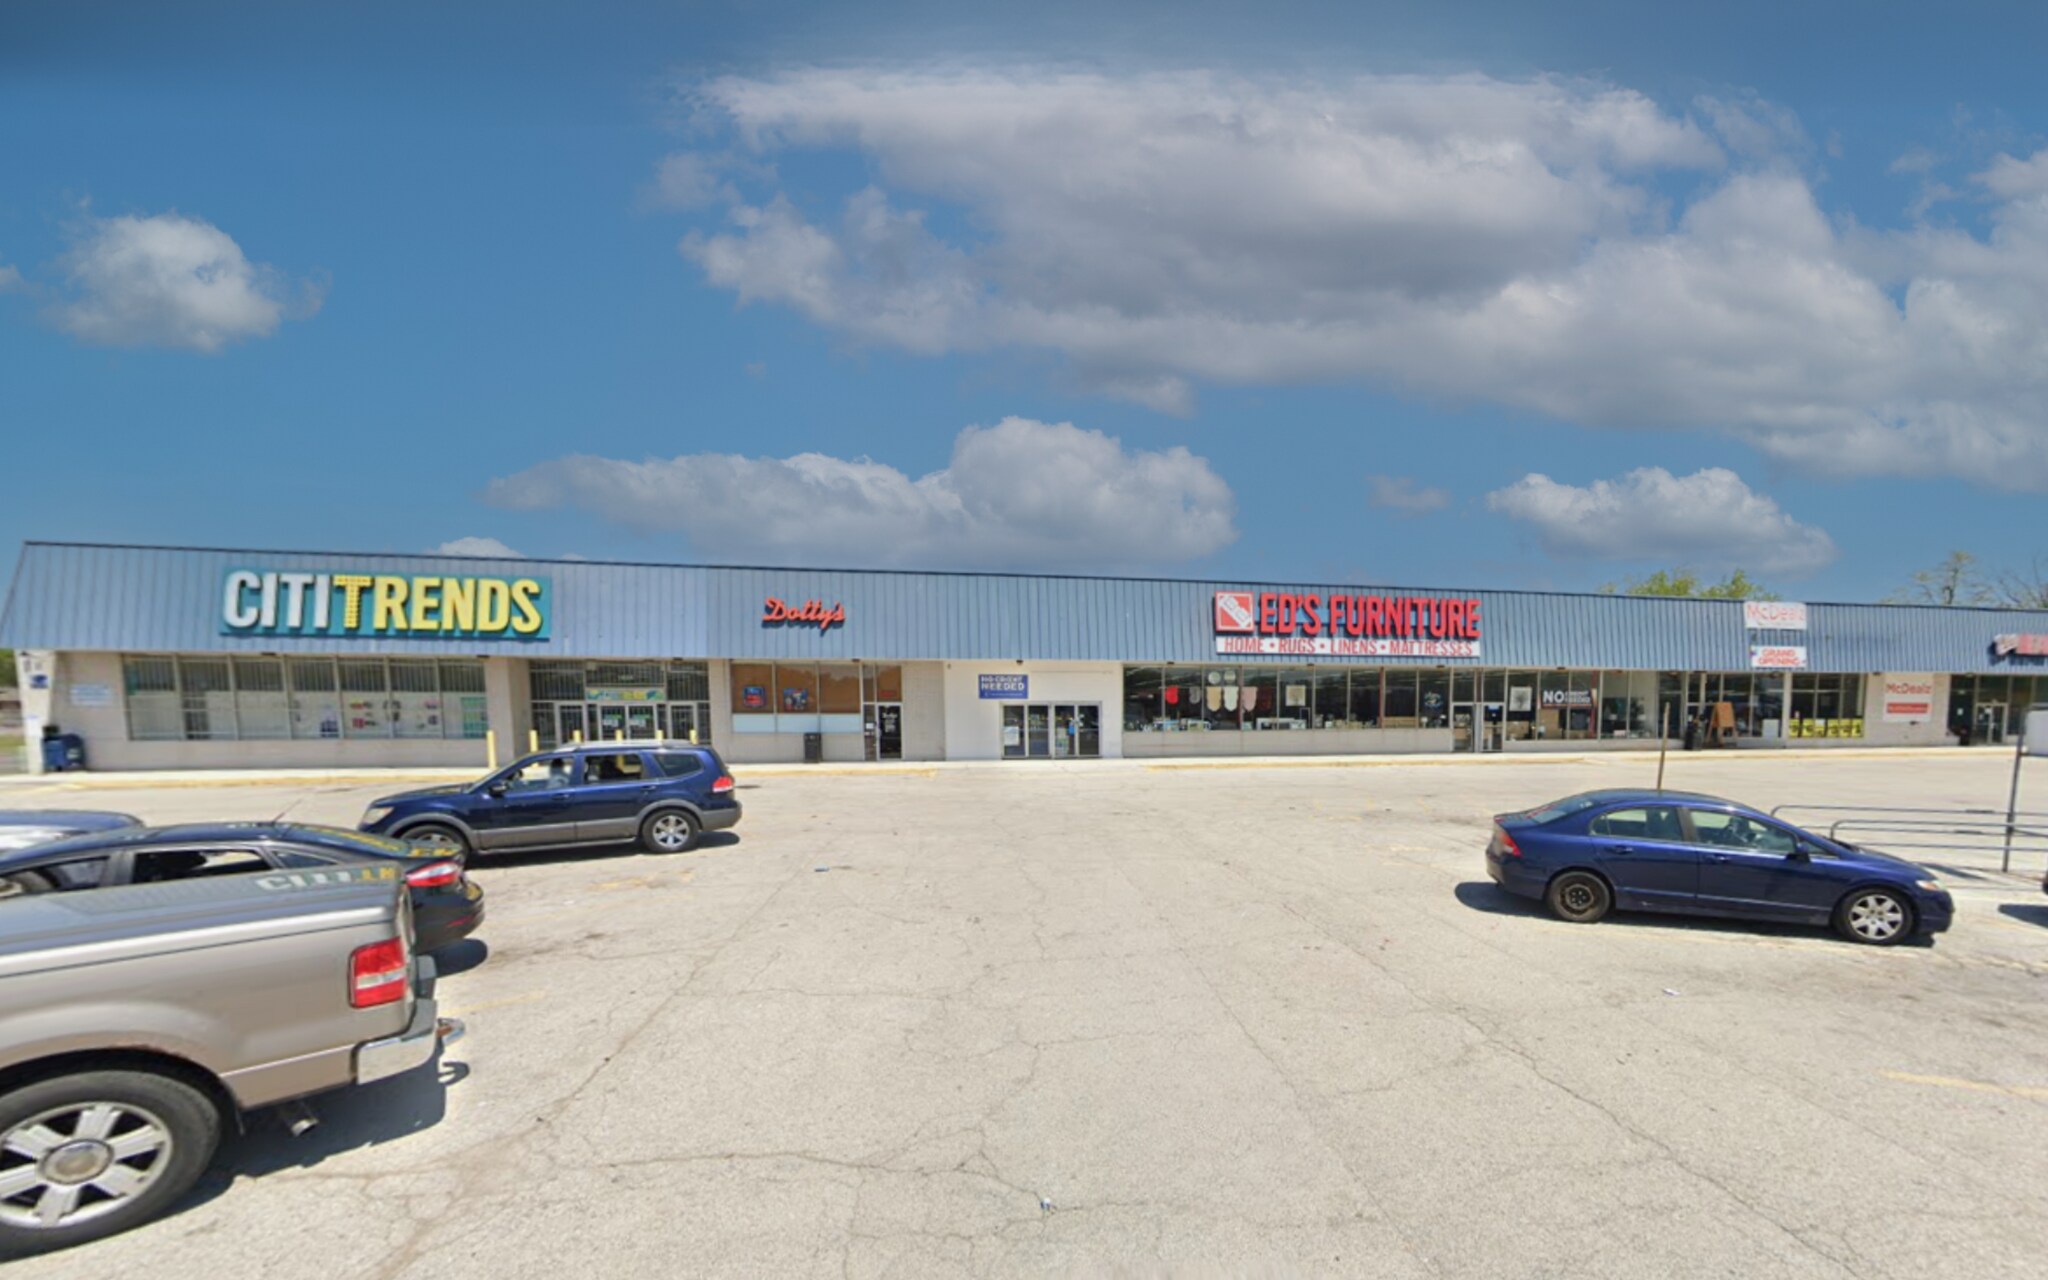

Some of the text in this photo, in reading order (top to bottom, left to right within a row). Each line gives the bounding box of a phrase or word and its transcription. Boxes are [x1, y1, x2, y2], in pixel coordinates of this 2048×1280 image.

[762, 596, 846, 630] Dotty's
[1259, 592, 1322, 635] ED'S
[1329, 594, 1482, 638] FURNITURE
[1224, 637, 1473, 657] HOME RUGS LINENS MATTRESSES
[980, 683, 1025, 691] NEEDED
[1543, 690, 1565, 704] NO
